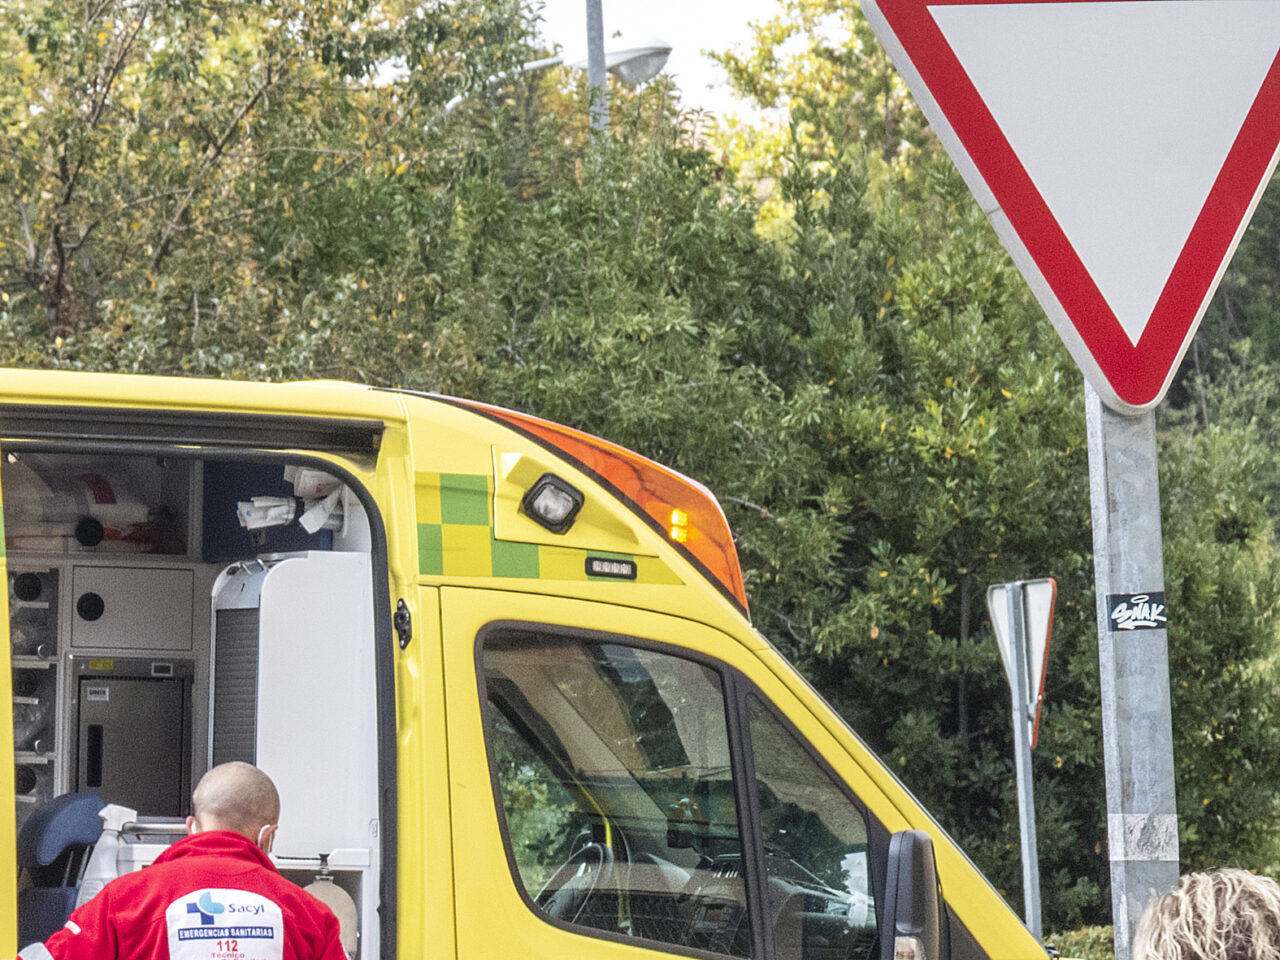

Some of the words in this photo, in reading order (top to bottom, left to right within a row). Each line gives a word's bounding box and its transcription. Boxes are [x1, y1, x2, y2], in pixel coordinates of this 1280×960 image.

[228, 903, 265, 915] Sacyl
[180, 928, 229, 938] EMERGENCIAS
[230, 928, 272, 937] SANITARIAS
[216, 939, 239, 952] 112
